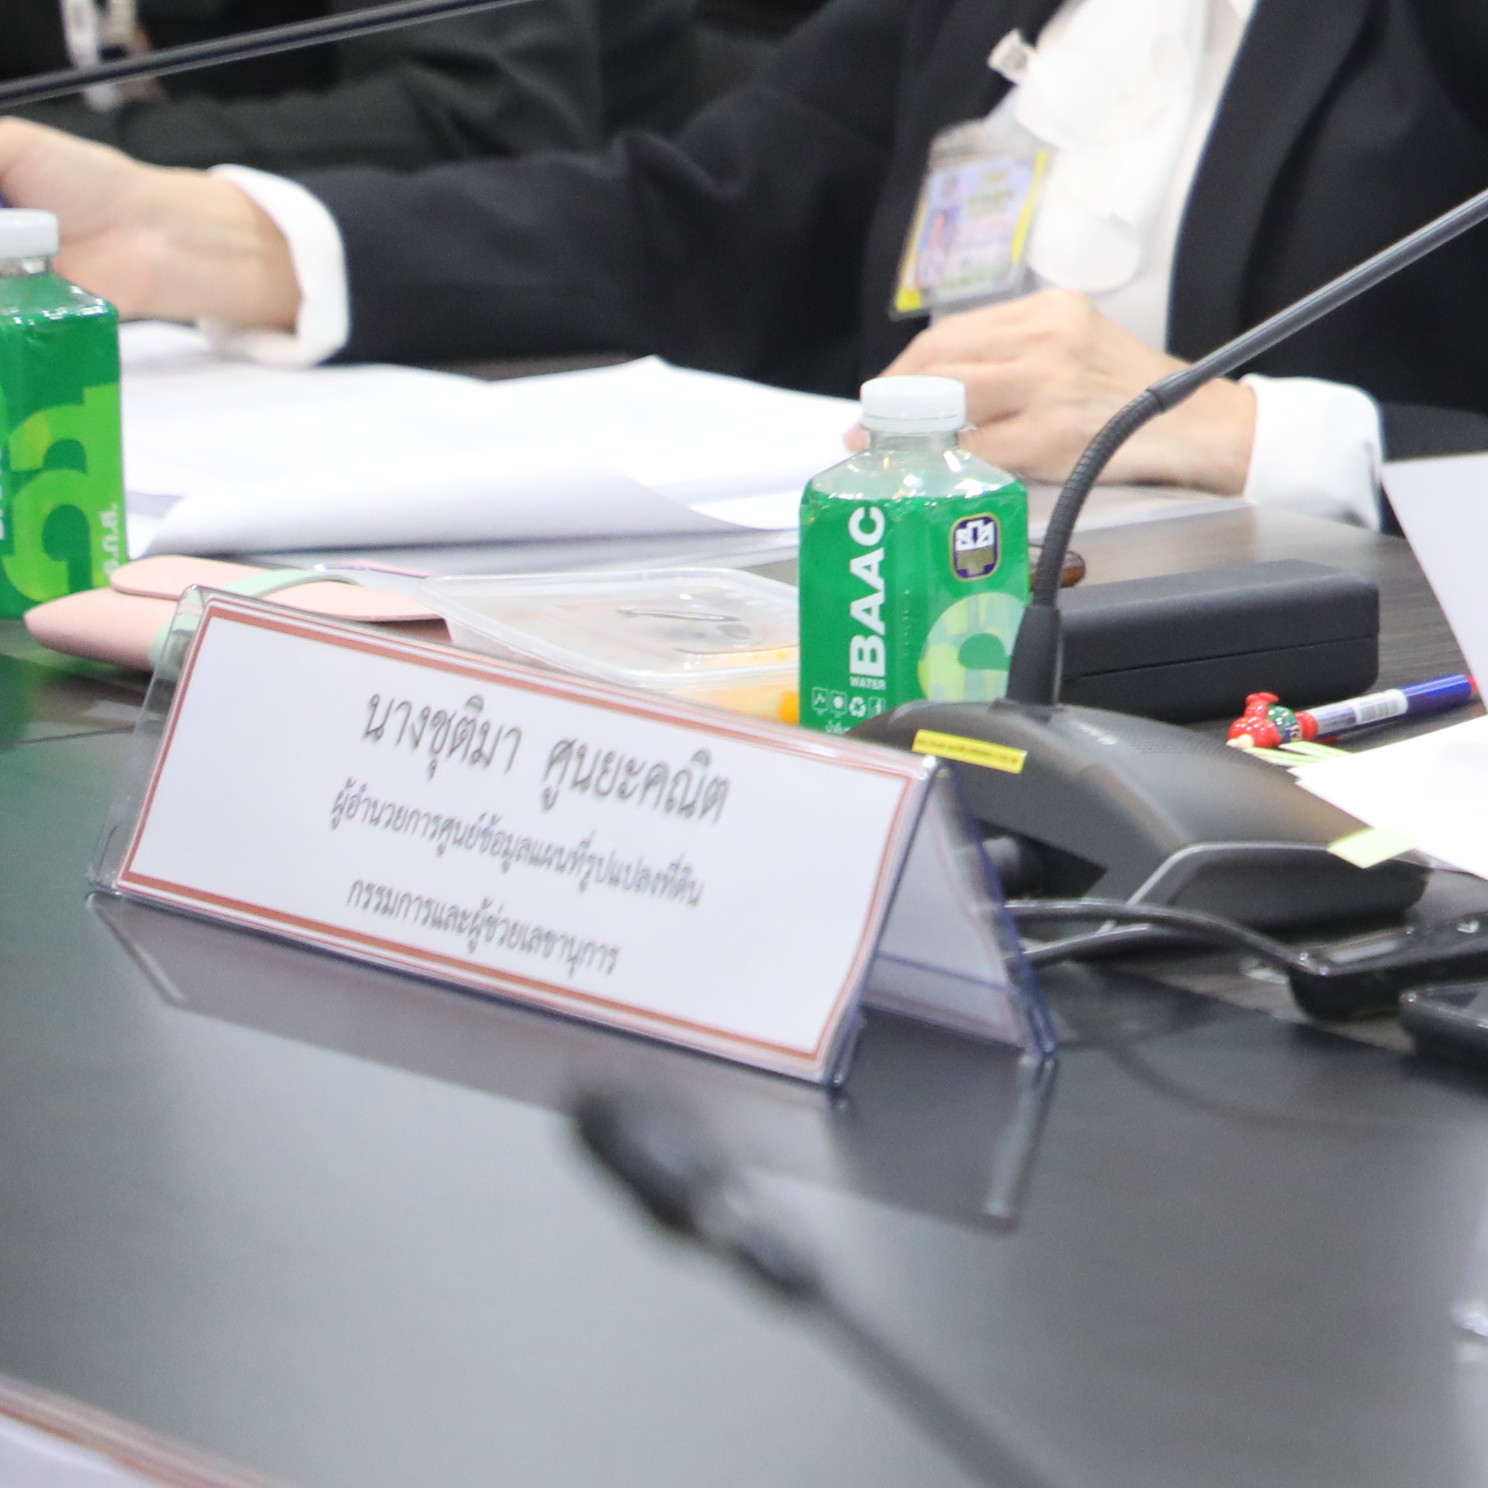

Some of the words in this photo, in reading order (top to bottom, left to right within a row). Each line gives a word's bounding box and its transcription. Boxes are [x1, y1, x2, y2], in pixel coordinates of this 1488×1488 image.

[849, 507, 887, 677] BAAC
[850, 676, 886, 691] WATER
[362, 693, 522, 780] นางชุติมา
[542, 738, 729, 823] ศูนยะคณิต
[348, 879, 620, 975] กรรมการและผู้ช่วยเลขานุการ
